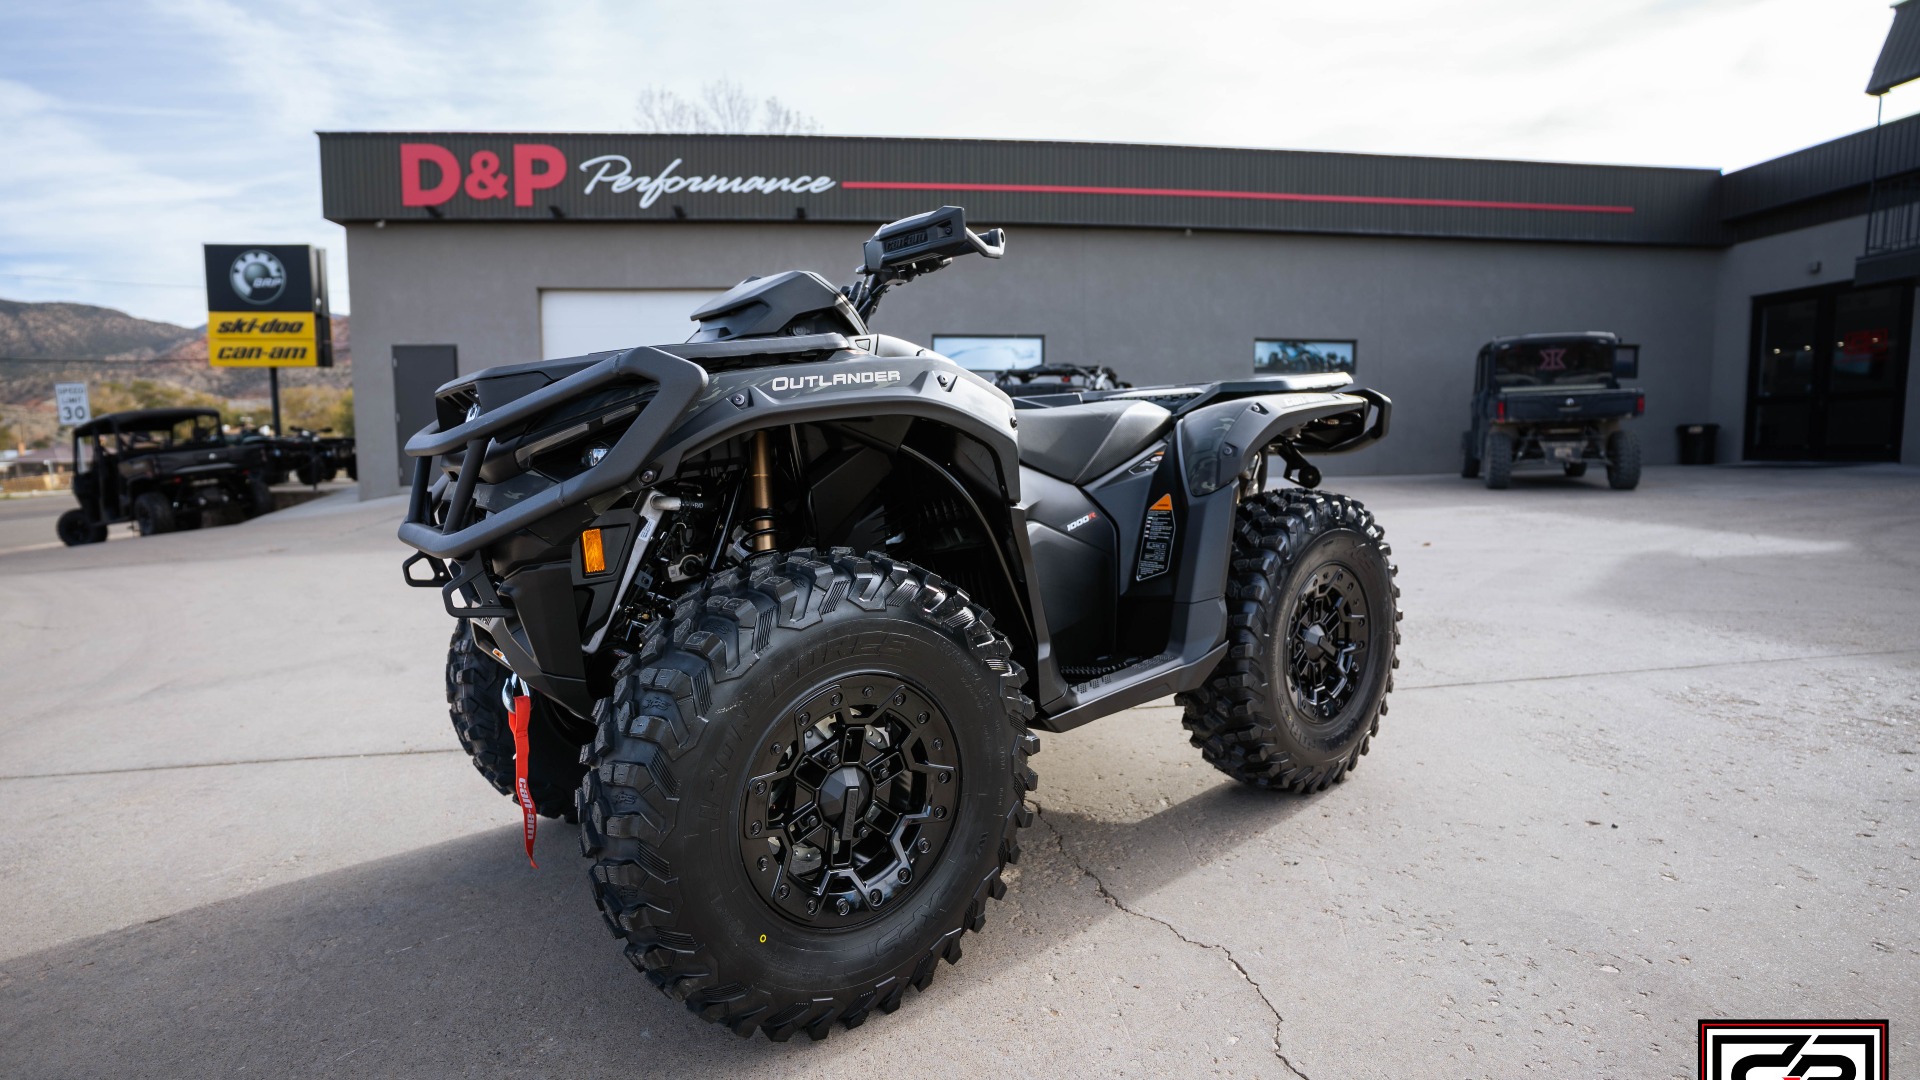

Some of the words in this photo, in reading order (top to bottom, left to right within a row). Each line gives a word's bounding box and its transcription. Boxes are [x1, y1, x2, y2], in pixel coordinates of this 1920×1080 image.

[399, 143, 567, 207] D&P
[578, 154, 837, 209] Performance
[217, 318, 304, 334] ski-doo
[217, 347, 307, 360] can-am
[772, 370, 900, 391] OUTLANDER
[62, 405, 85, 420] 30
[1066, 511, 1097, 532] 1000R
[518, 777, 534, 840] can-am
